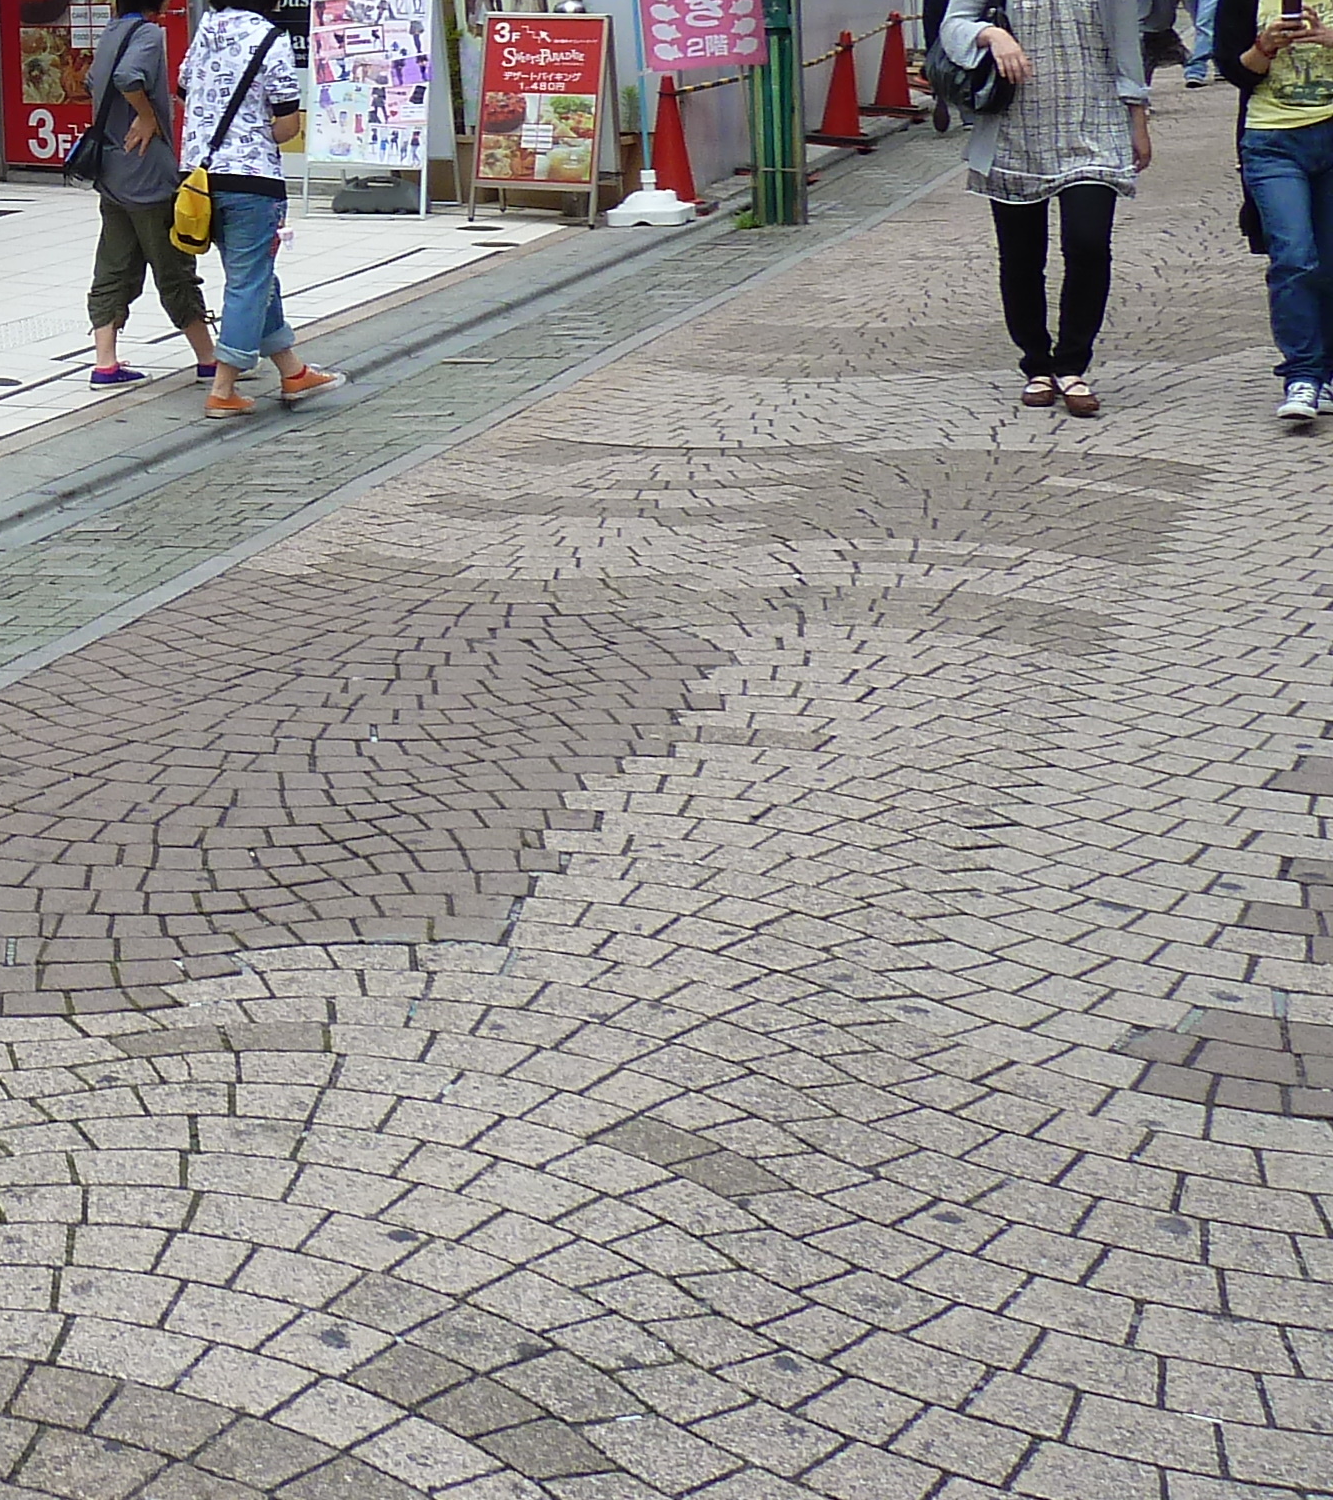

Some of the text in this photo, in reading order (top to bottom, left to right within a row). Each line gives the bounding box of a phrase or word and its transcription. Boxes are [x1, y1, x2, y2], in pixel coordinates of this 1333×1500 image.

[493, 22, 522, 43] 3F
[686, 35, 729, 58] 2階
[502, 70, 582, 82] デザートバイキング
[28, 108, 73, 160] 3F
